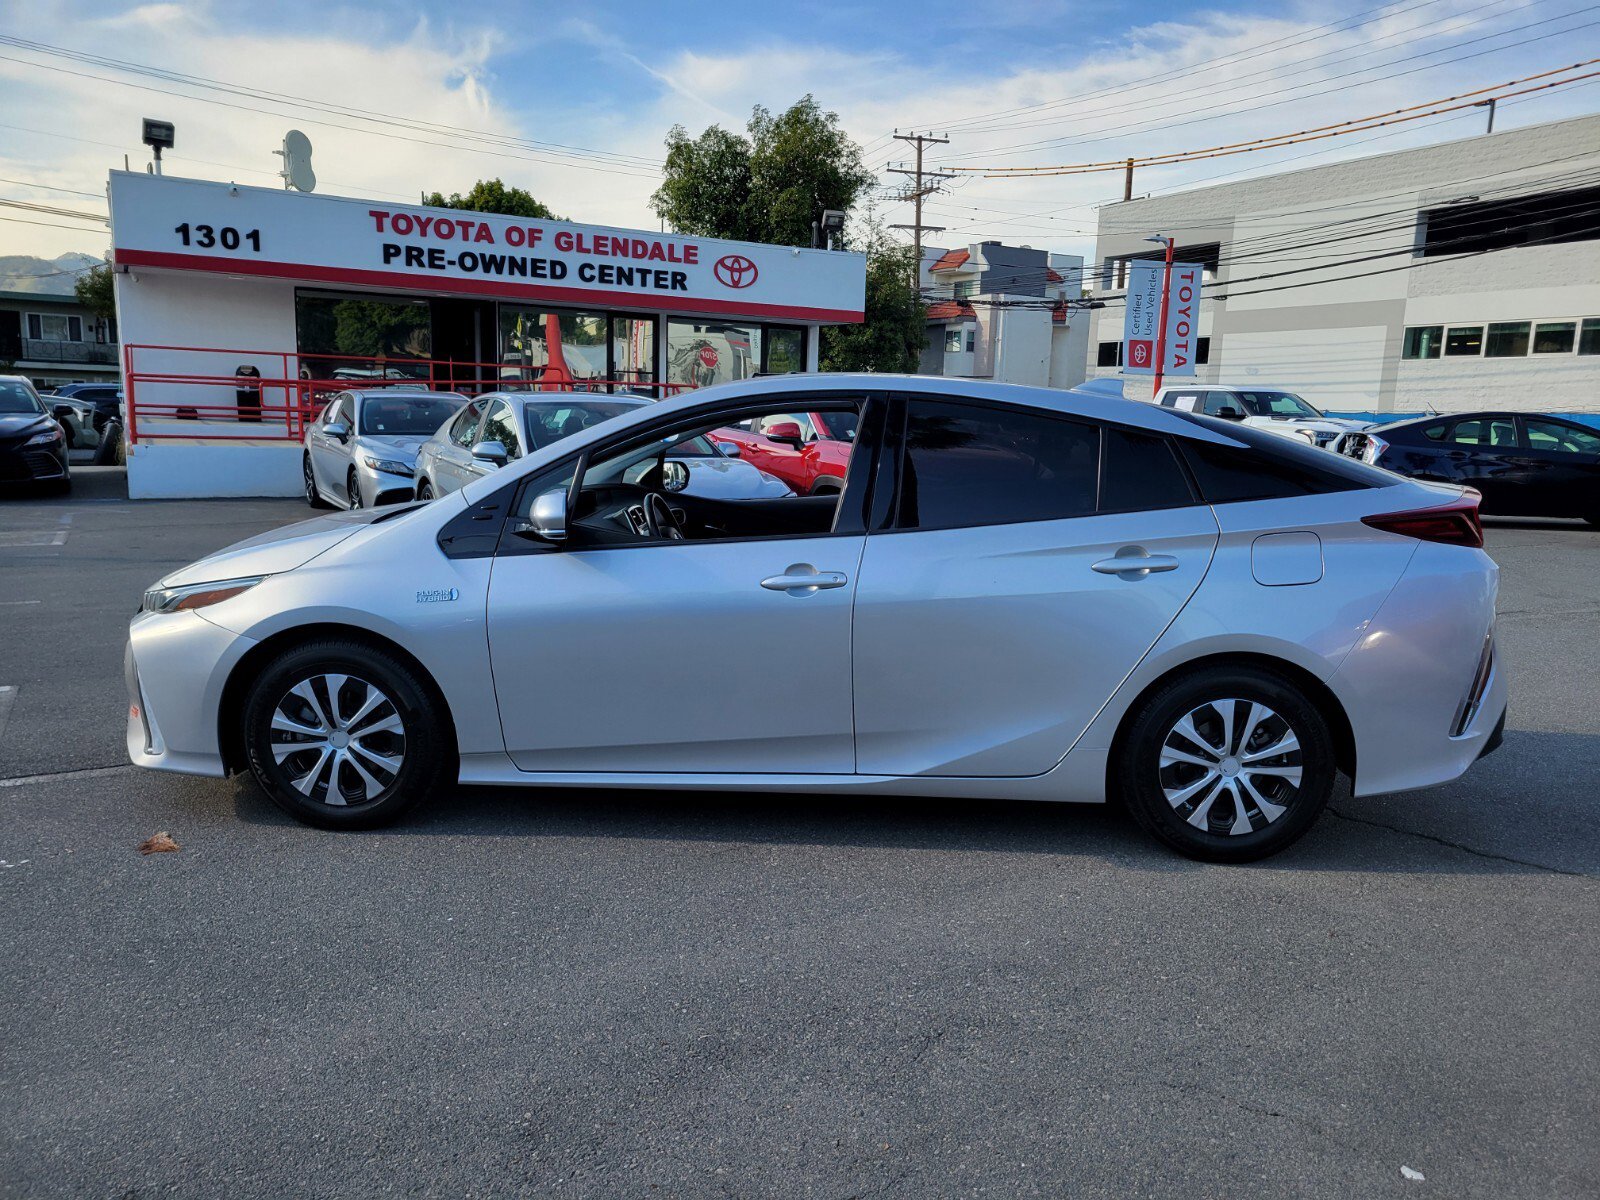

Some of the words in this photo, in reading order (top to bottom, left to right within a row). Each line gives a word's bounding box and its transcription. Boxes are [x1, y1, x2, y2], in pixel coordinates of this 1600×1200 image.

[175, 223, 261, 252] 1301
[369, 211, 494, 244] TOYOTA
[505, 226, 543, 247] OF
[554, 231, 699, 265] GLENDALE
[382, 243, 568, 280] PRE-OWNED
[577, 262, 688, 291] CENTER
[1145, 268, 1158, 309] Vehicles
[1131, 294, 1143, 336] Certified
[1144, 311, 1154, 336] Used
[1174, 271, 1194, 368] TOYOTA
[416, 595, 450, 603] HYBRID
